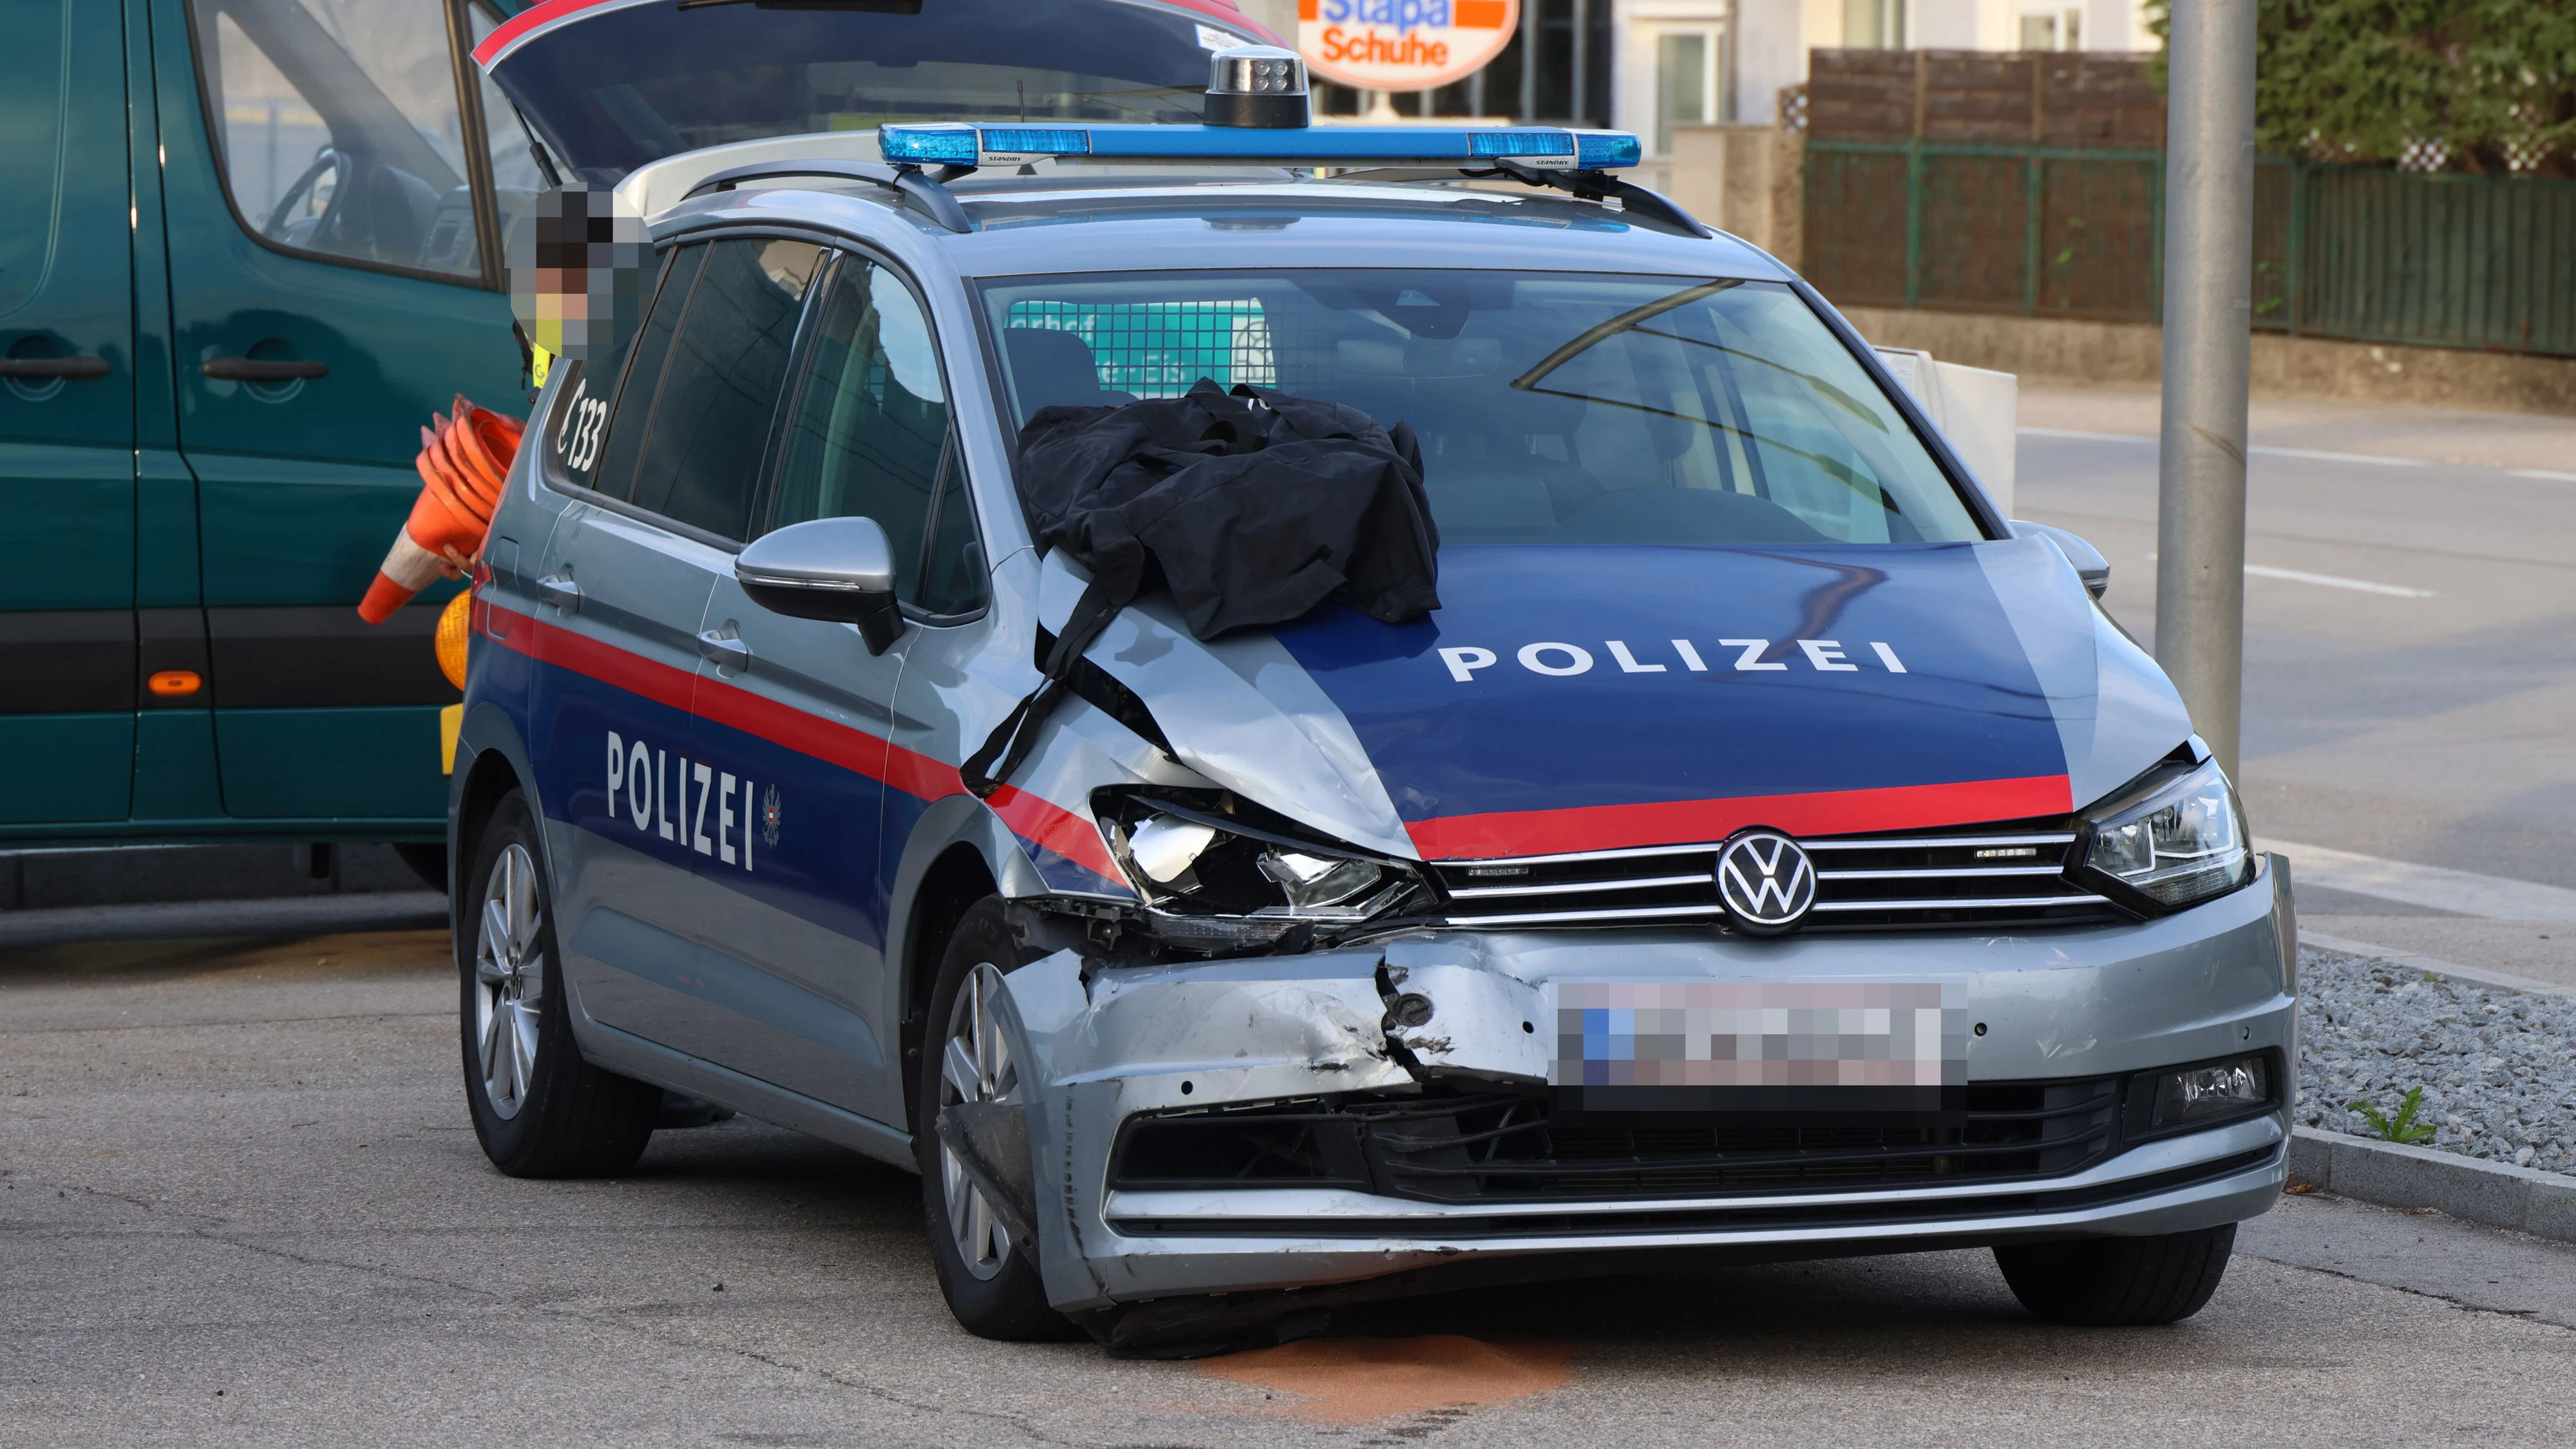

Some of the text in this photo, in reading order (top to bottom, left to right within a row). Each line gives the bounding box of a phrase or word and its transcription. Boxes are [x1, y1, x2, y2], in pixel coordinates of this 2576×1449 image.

[1323, 27, 1448, 65] Schuhe
[567, 397, 607, 472] 133
[1437, 638, 1908, 683] POLIZEI
[607, 730, 754, 872] POLIZEI
